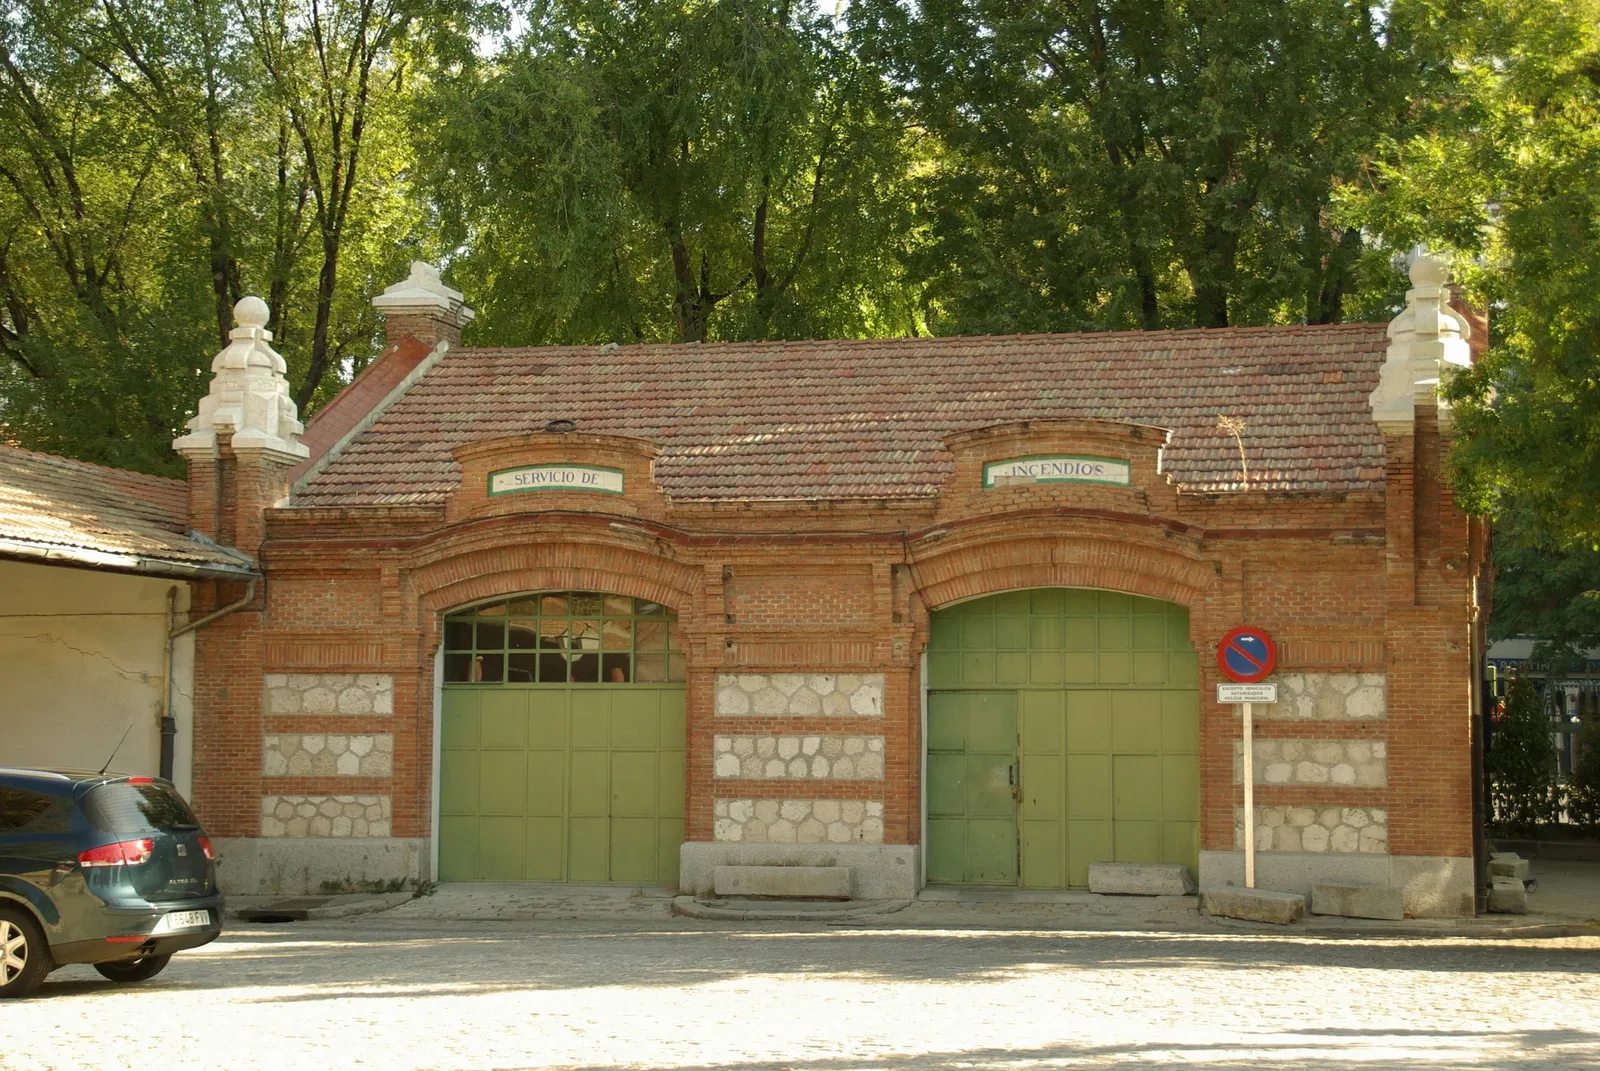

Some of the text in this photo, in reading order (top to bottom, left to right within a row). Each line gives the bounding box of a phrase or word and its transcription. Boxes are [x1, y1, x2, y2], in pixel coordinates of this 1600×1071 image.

[1012, 462, 1104, 477] INCENDIOS
[514, 471, 600, 486] SERVICIO DE
